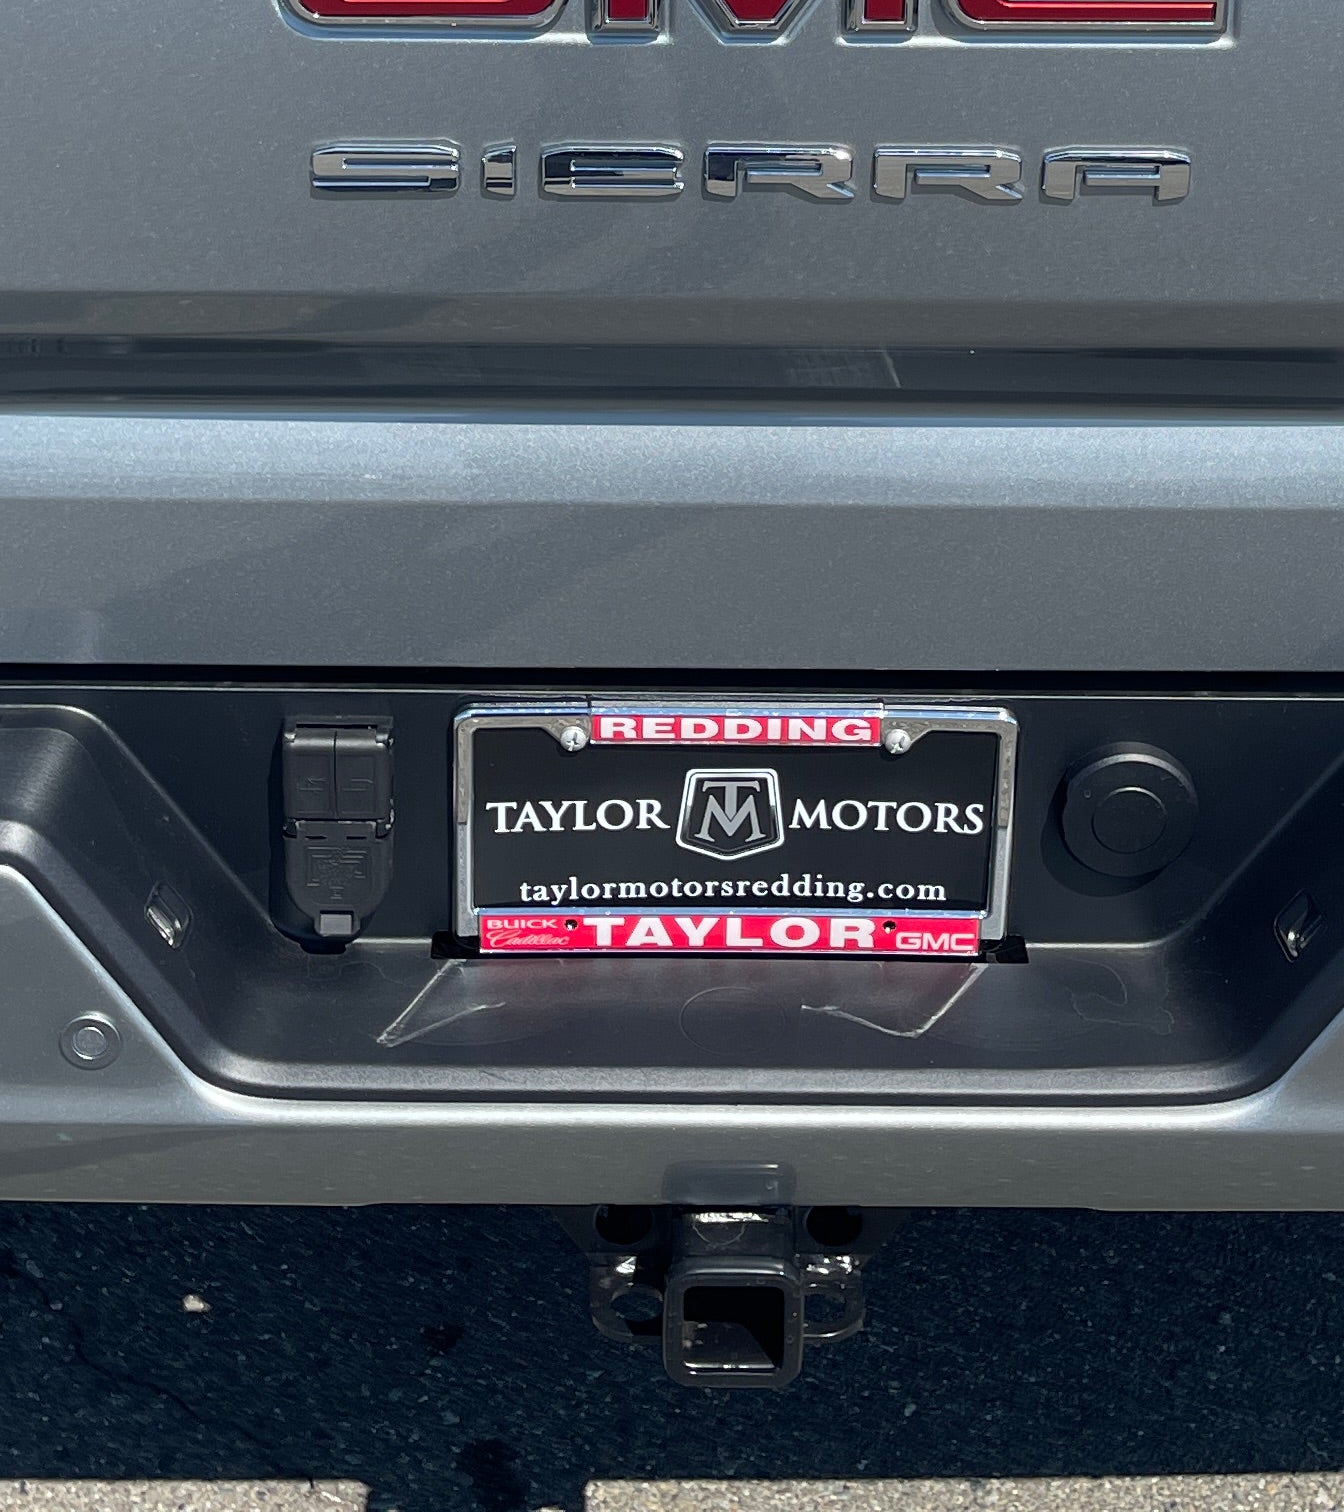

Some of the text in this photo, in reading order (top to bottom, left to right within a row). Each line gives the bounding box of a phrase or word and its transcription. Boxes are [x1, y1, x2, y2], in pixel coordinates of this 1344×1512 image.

[311, 140, 1193, 202] SIERRA
[599, 716, 874, 742] REDDING
[486, 798, 985, 835] TAYLOR MOTORS
[519, 873, 947, 905] taylormotorsredding.com
[487, 918, 558, 929] BUICK
[583, 916, 876, 948] TAYLOR
[486, 929, 570, 948] Cadillac
[895, 932, 975, 950] GMC
